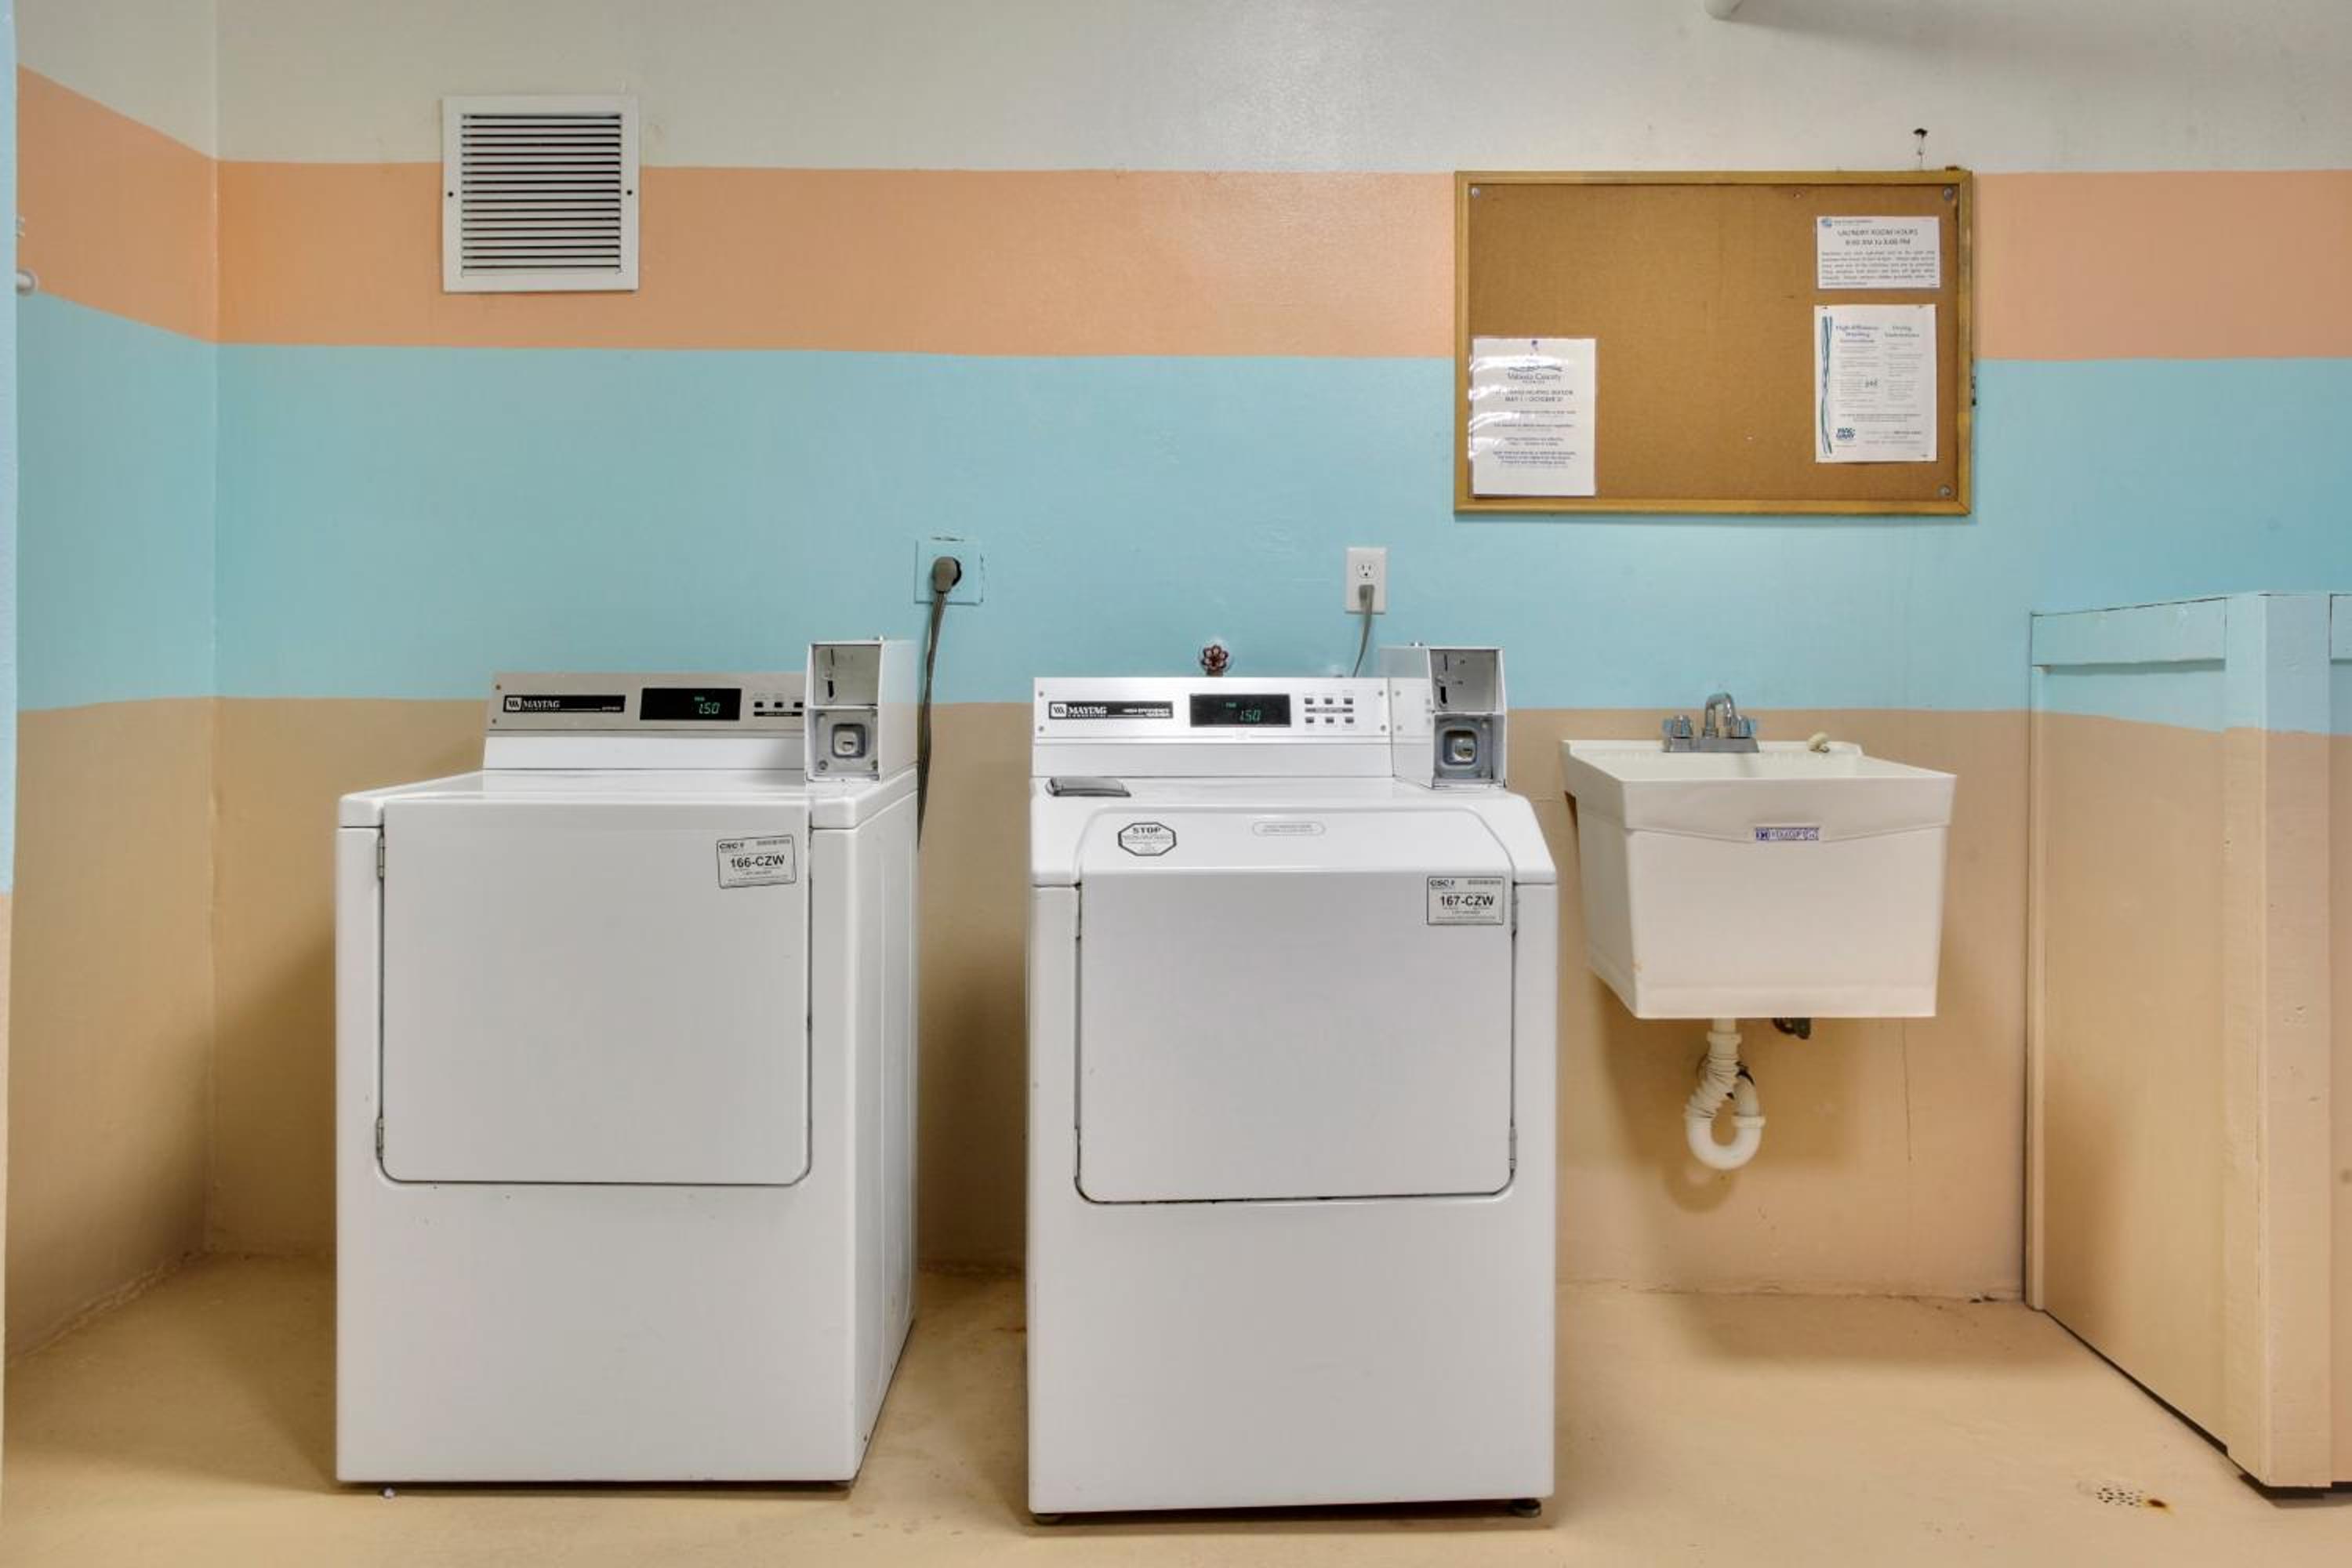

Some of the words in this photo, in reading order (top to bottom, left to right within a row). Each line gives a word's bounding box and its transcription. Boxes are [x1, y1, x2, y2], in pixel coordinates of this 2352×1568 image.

[523, 700, 561, 709] MAYTAG
[1067, 706, 1108, 714] MAYTAG
[730, 855, 786, 869] 166-CZW
[1440, 895, 1494, 906] 167-CZW
